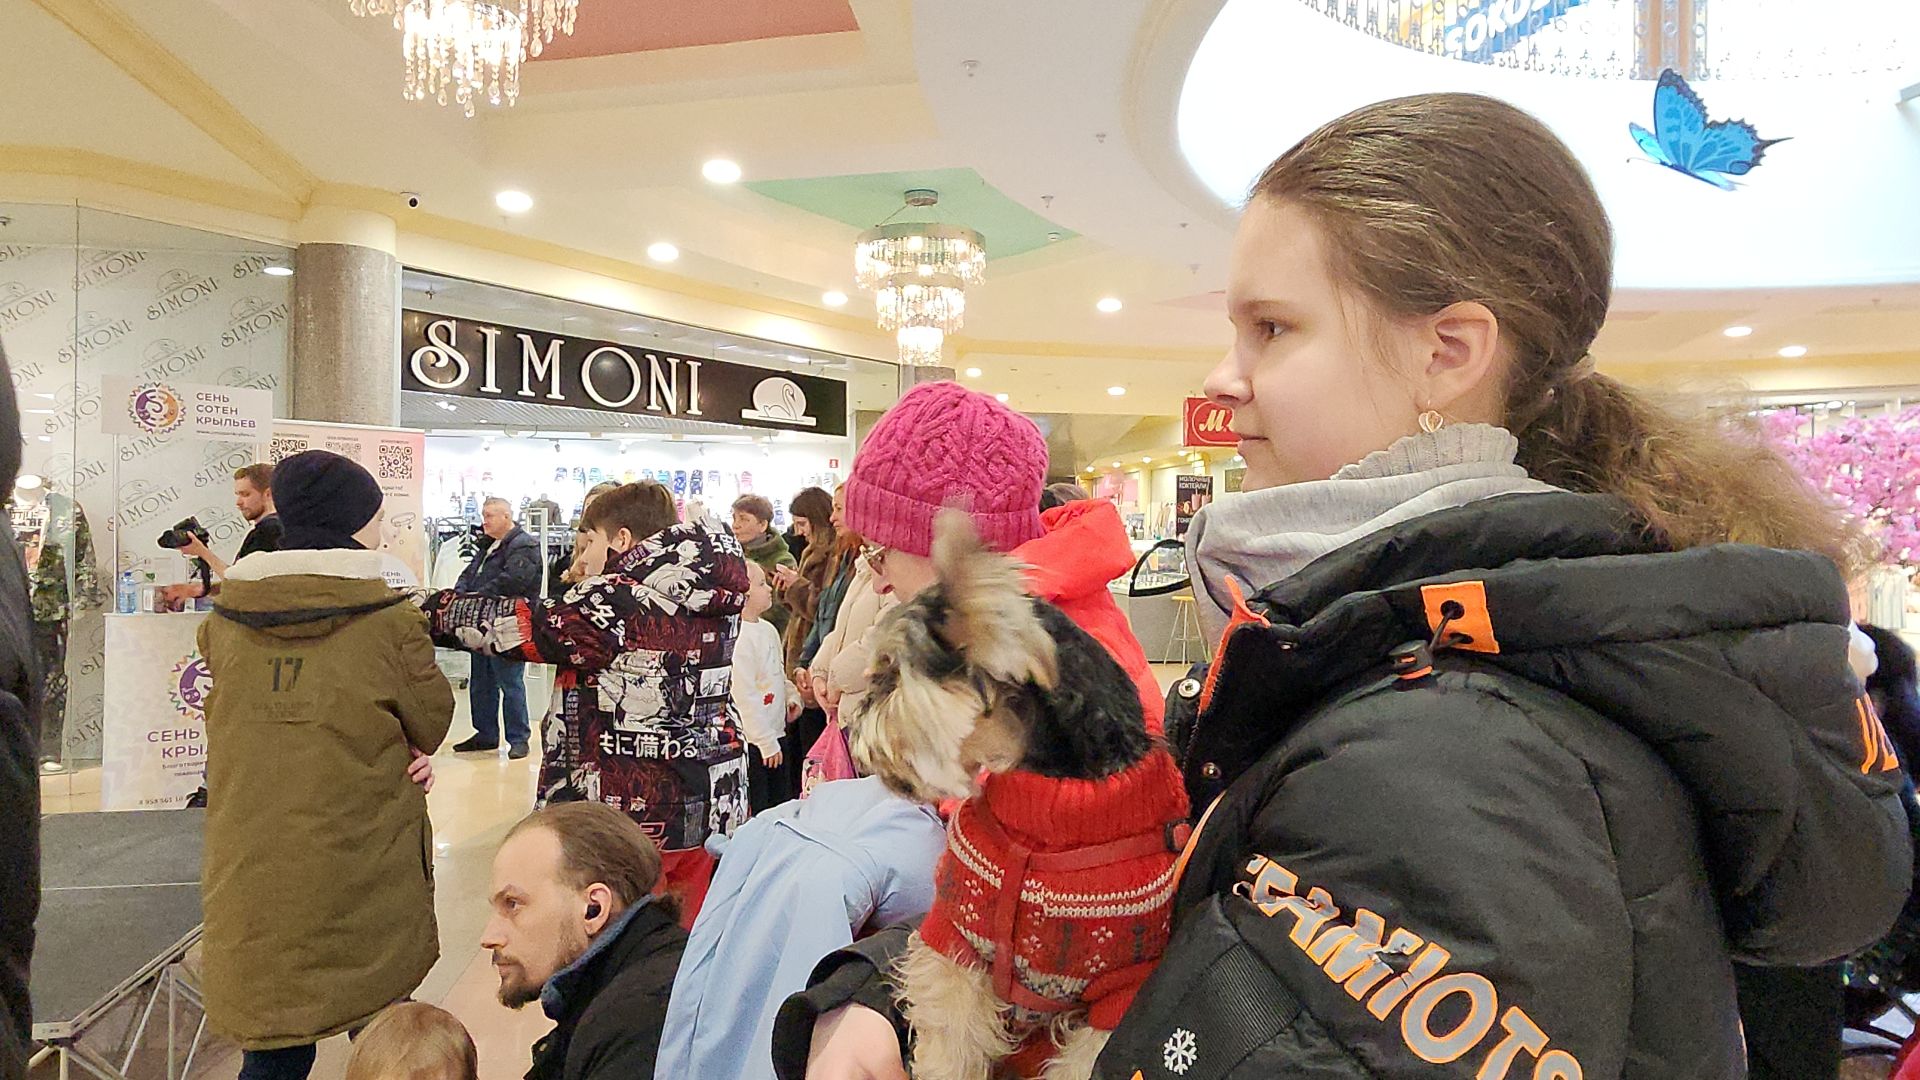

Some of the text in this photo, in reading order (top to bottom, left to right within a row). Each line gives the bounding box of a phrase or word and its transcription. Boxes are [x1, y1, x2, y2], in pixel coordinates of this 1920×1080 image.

[233, 256, 282, 279] SIM
[0, 290, 57, 328] MONI
[146, 276, 219, 320] SIMONI
[58, 319, 132, 363] SIMONI
[221, 303, 289, 348] SIMONI
[136, 346, 206, 382] IMONI
[410, 319, 703, 416] SIMONI
[45, 395, 102, 434] SIMO
[196, 392, 230, 403] СЕНЬ
[196, 404, 239, 416] СОТЕН
[196, 416, 256, 429] КРЫЛЬЕВ
[147, 728, 200, 743] СЕНЬ
[162, 743, 207, 759] КРЫ
